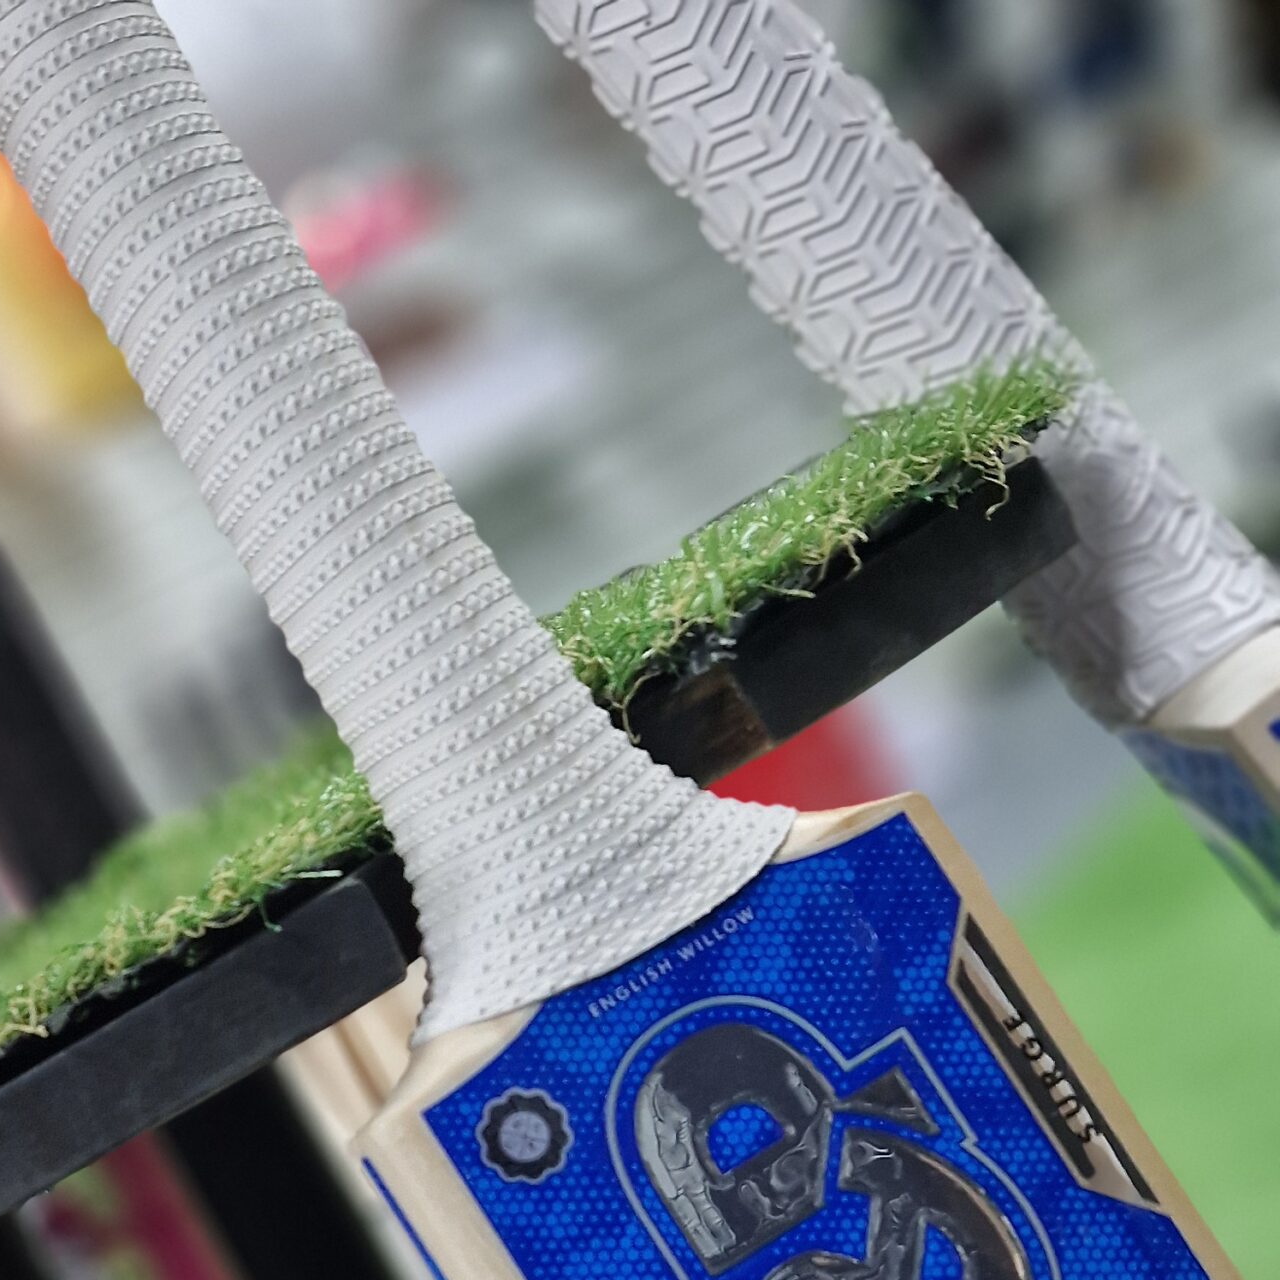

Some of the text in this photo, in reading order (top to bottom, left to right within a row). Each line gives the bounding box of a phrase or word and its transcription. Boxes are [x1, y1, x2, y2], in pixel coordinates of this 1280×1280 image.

[588, 905, 755, 1019] ENGLISH WILLOW
[1003, 1016, 1099, 1142] SURGE
